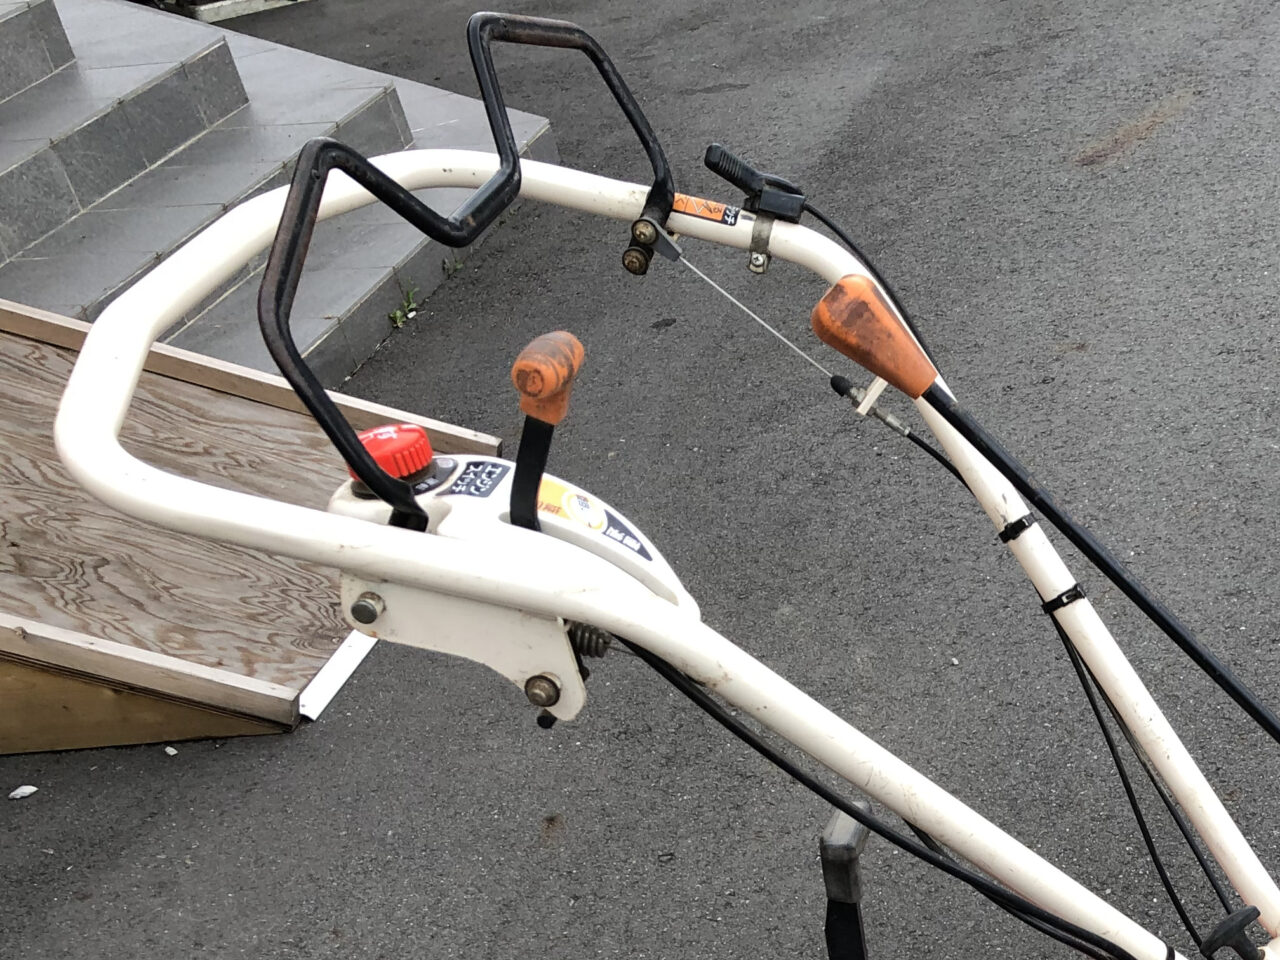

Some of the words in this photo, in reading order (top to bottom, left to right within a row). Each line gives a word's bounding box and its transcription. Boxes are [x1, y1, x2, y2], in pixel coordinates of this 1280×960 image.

[452, 464, 483, 492] スイッチ
[470, 465, 502, 495] エンジン
